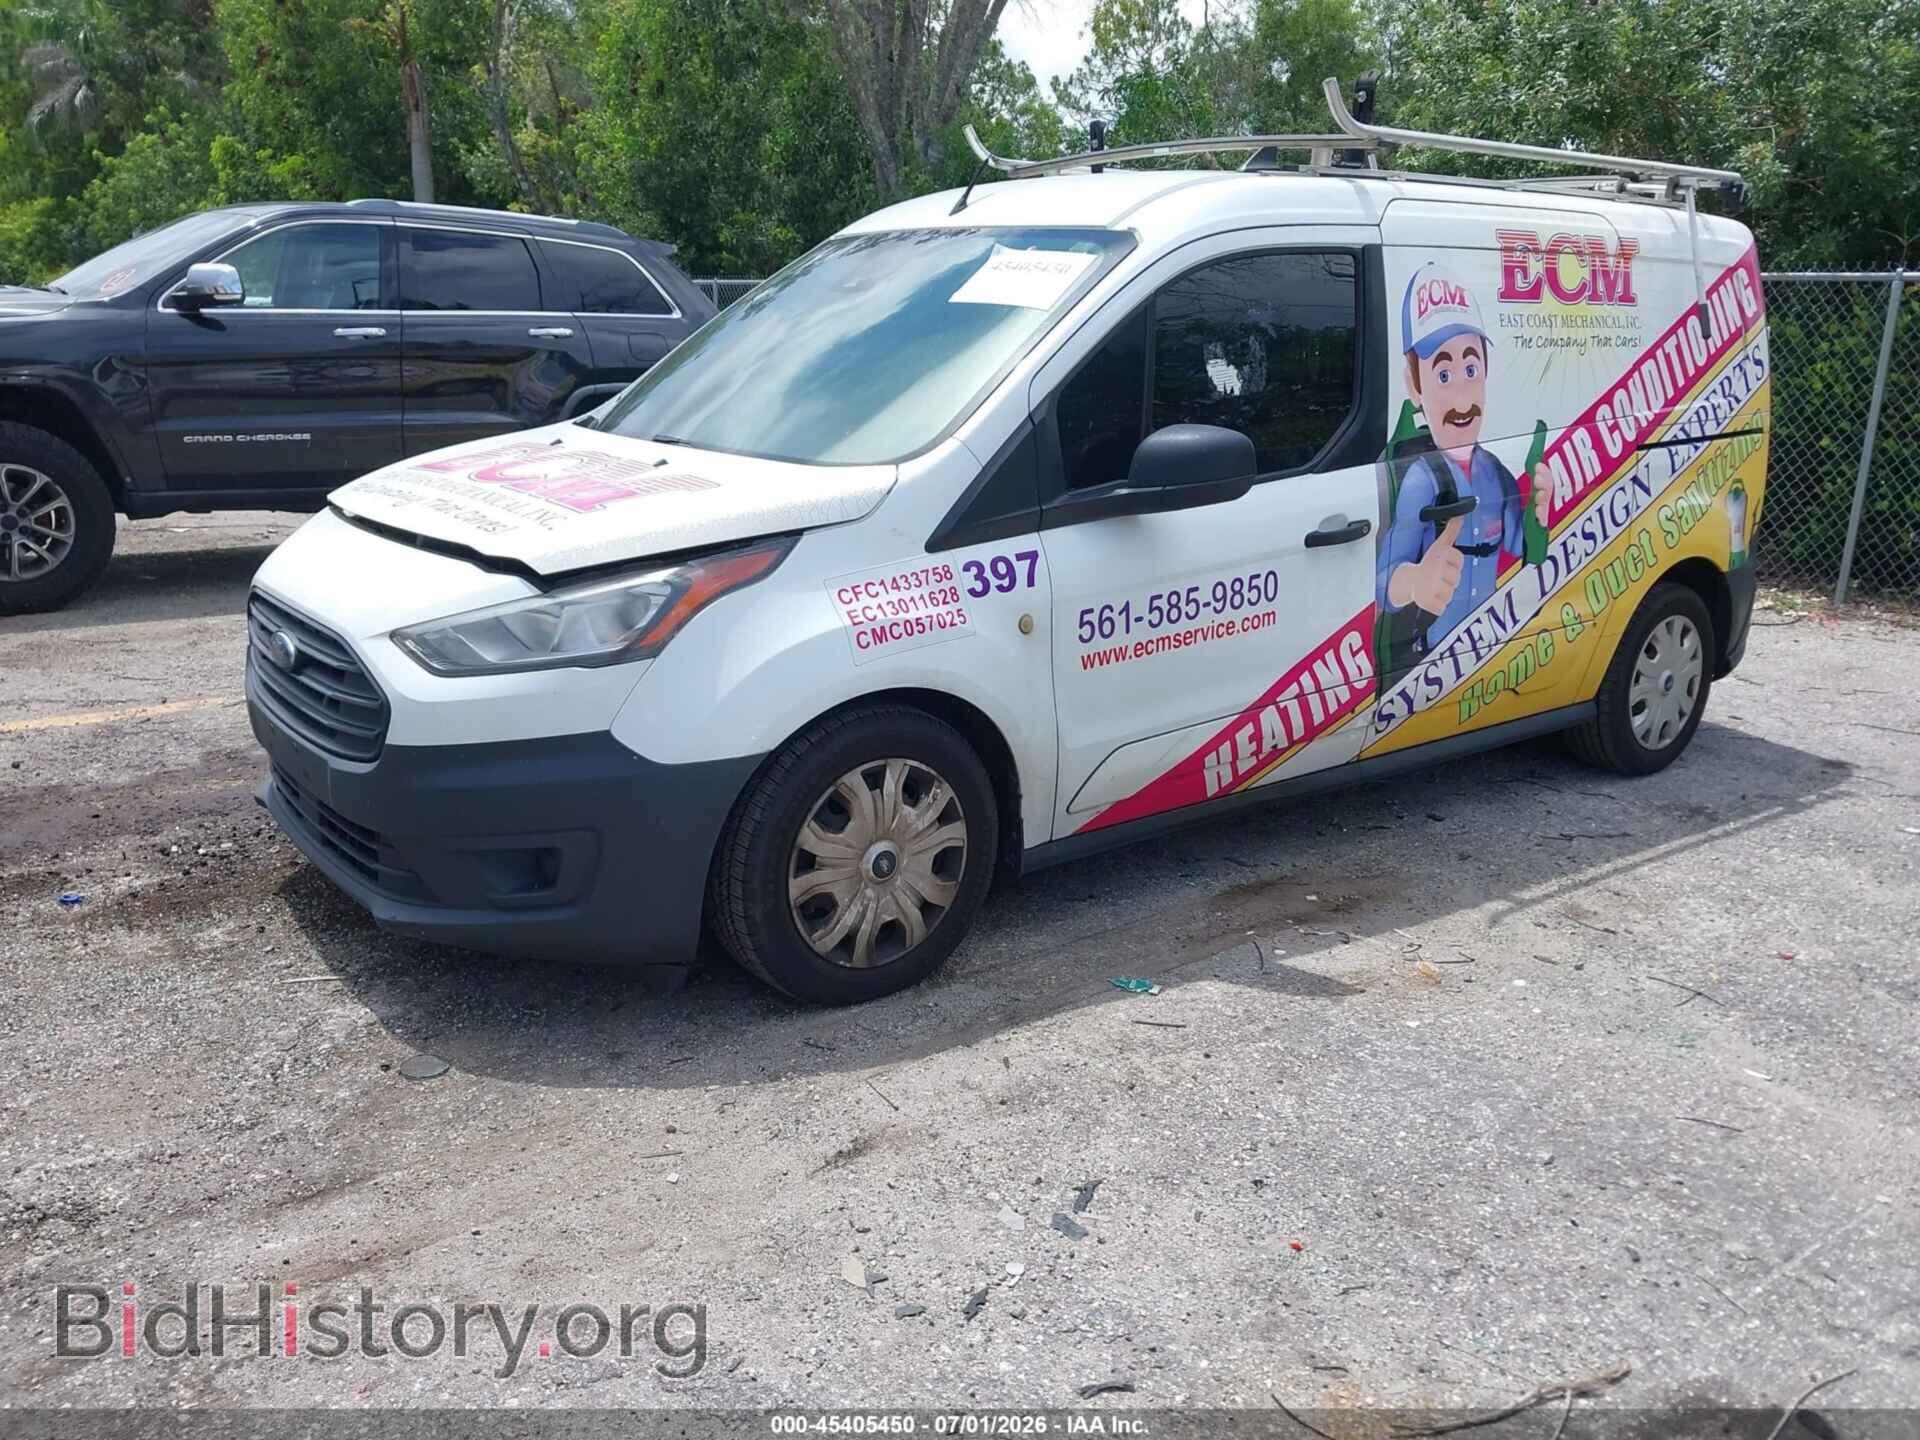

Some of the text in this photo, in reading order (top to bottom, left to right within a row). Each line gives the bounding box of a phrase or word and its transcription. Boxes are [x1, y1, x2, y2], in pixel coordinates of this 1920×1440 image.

[1496, 229, 1640, 306] ECM
[1417, 279, 1470, 319] ECM
[1499, 314, 1524, 328] EAST
[1526, 313, 1558, 329] COAST
[1513, 334, 1532, 349] The
[1535, 334, 1587, 356] Company
[1590, 333, 1612, 348] That
[183, 433, 312, 443] GRAND CHEROKEE
[1548, 426, 1602, 512] AIR
[1374, 344, 1765, 734] SYSTEM DESIGN EXPERTS
[837, 564, 954, 605] CFC1433758
[962, 550, 1039, 598] 397
[847, 586, 960, 626] EC13011628
[856, 608, 967, 649] CMC057025
[1078, 570, 1279, 644] 561-585-9850
[1458, 628, 1555, 726] Home
[1560, 601, 1585, 643] &
[1583, 527, 1658, 617] Duct
[1080, 610, 1276, 671] www.ecmservice.com
[1203, 631, 1374, 798] HEATING
